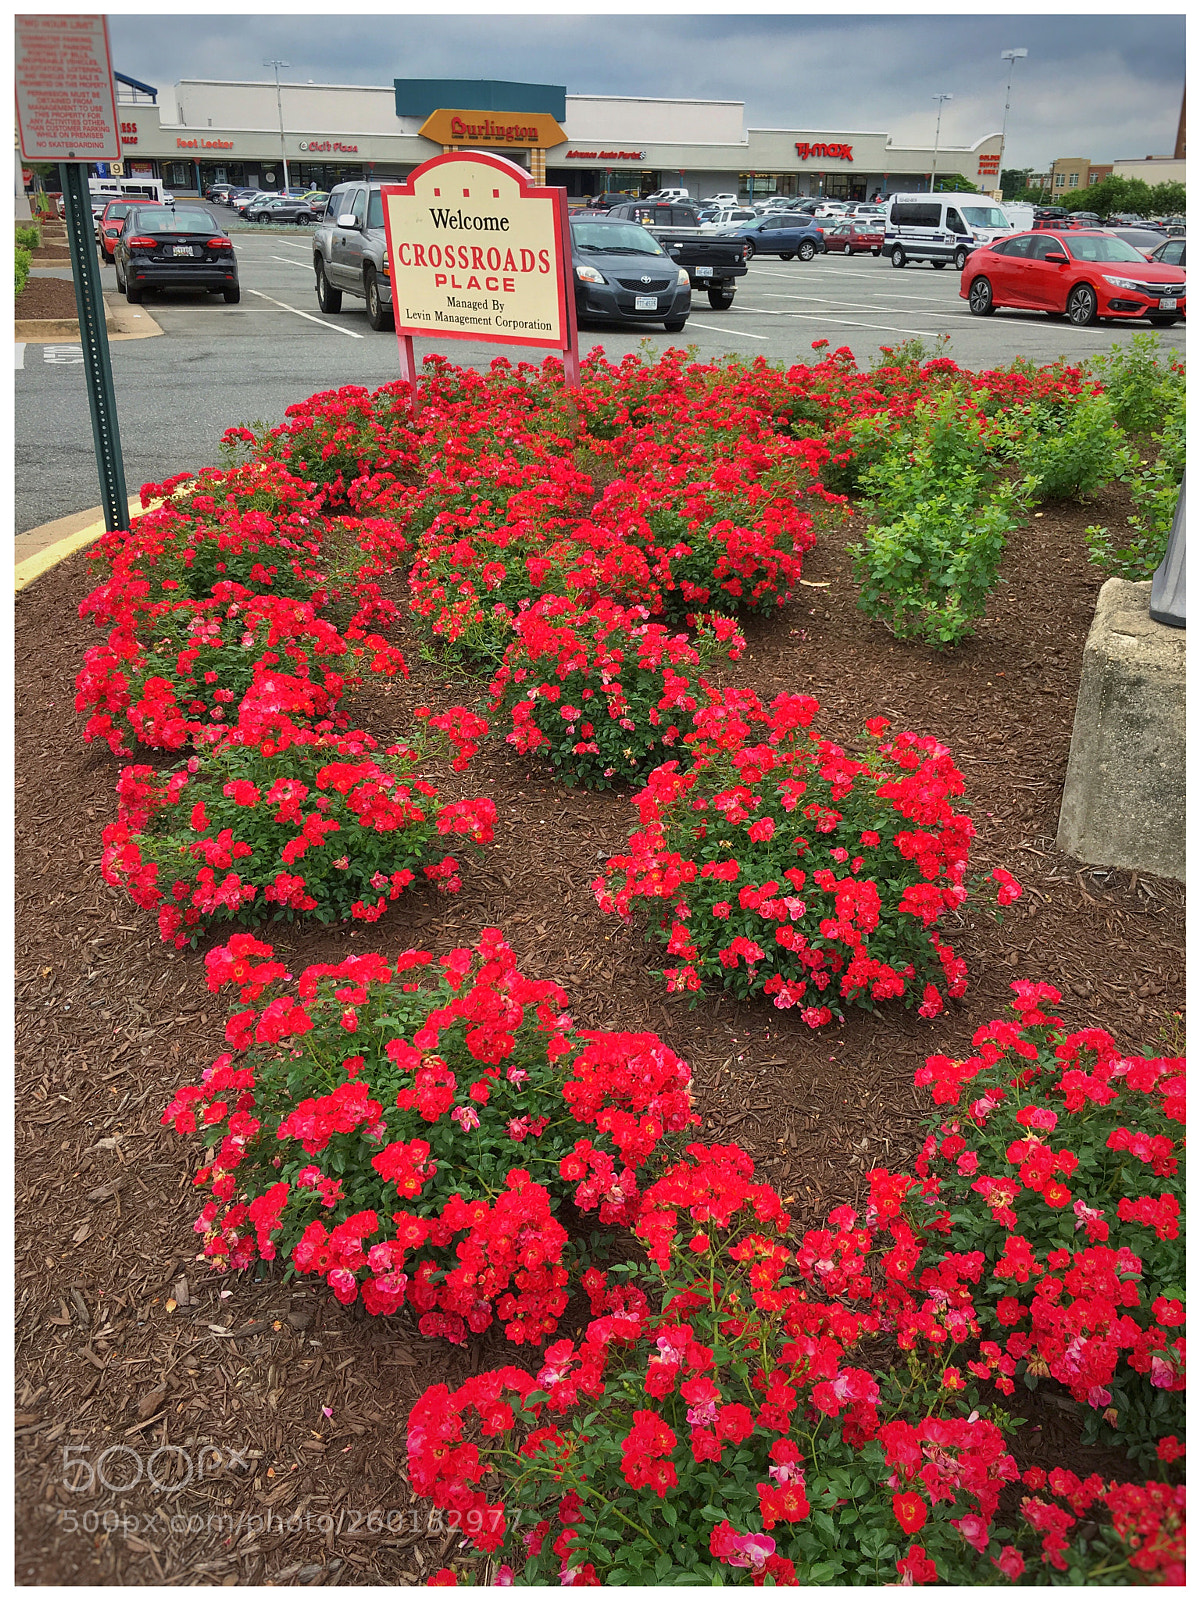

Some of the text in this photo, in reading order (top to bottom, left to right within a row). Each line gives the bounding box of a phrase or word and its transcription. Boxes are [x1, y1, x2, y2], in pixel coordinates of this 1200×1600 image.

[90, 105, 103, 113] USE
[451, 116, 539, 142] Burlington
[48, 141, 104, 149] SKATEBOARDING
[176, 137, 234, 149] Foot Locker
[565, 150, 641, 160] Advance Auto Parts
[112, 163, 121, 174] 9
[429, 208, 510, 232] Welcome
[398, 242, 551, 274] CROSSROADS
[434, 273, 516, 293] PLACE
[446, 296, 505, 313] Managed By
[406, 308, 552, 331] Levin Management Corporation
